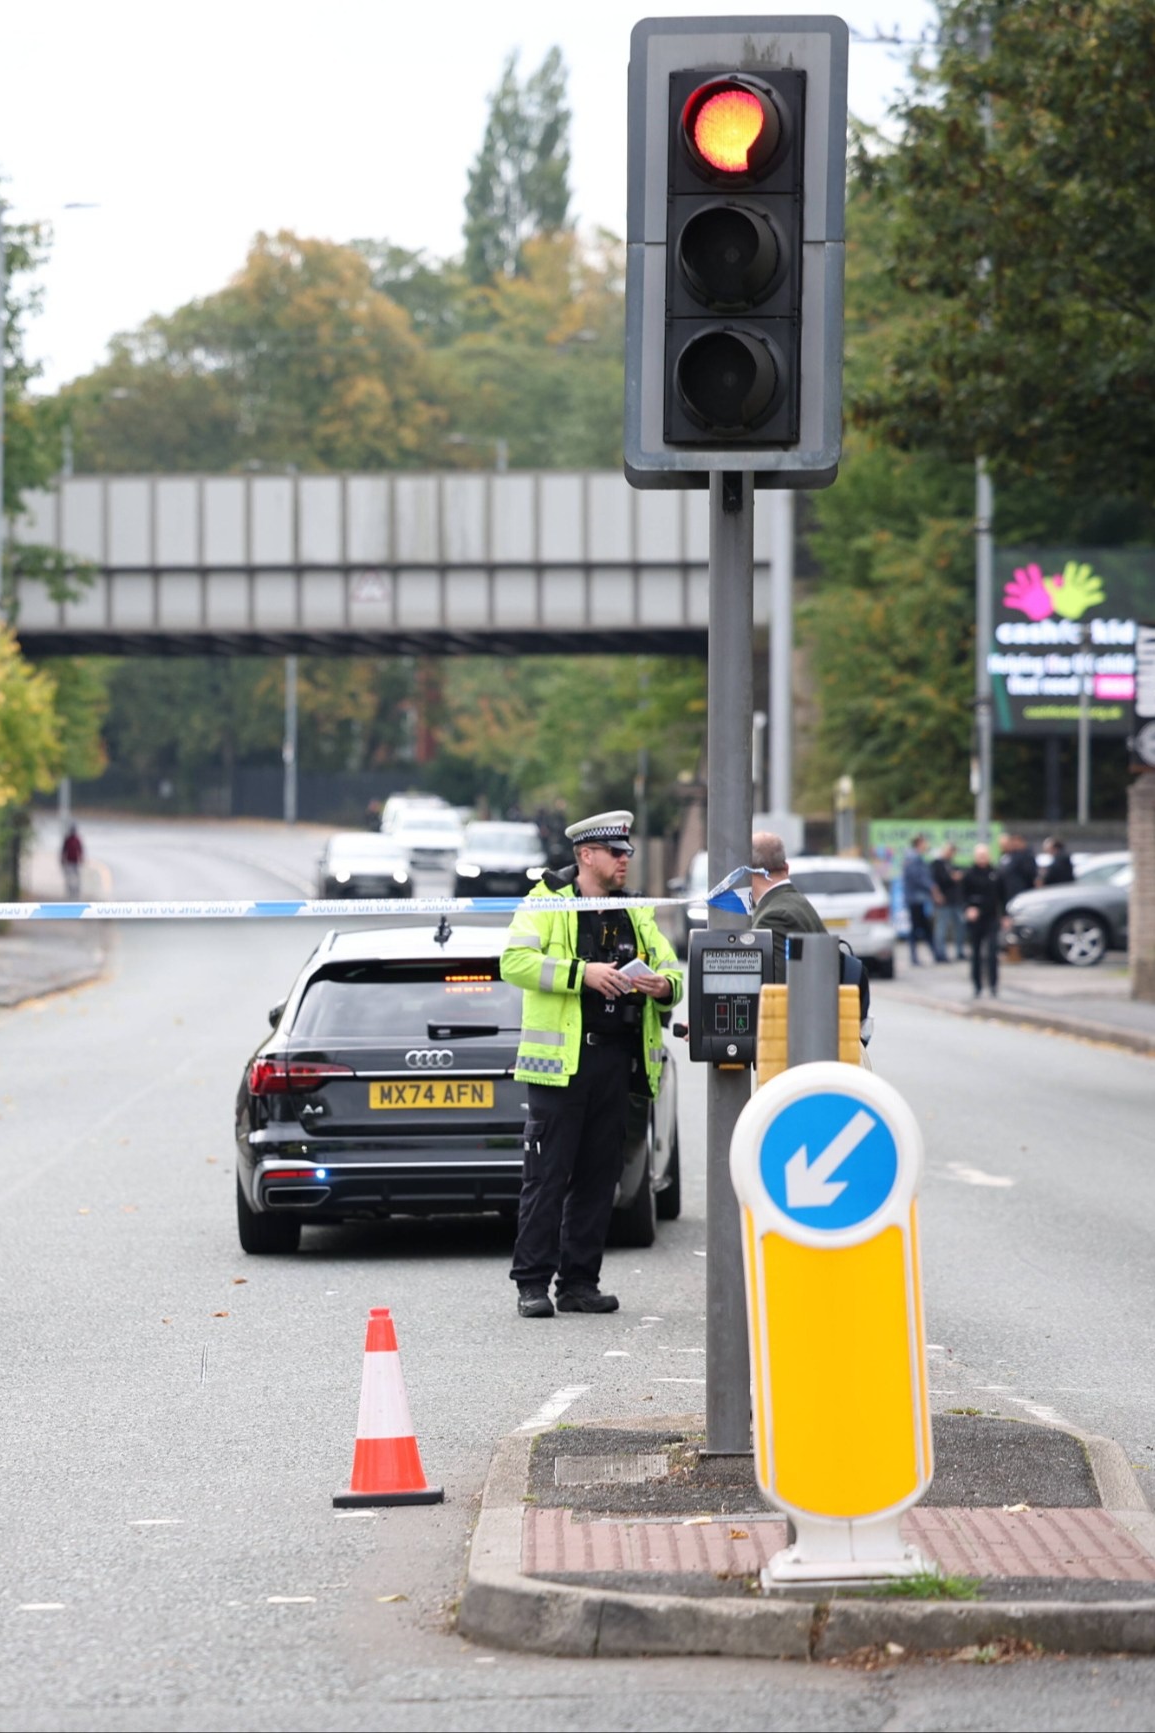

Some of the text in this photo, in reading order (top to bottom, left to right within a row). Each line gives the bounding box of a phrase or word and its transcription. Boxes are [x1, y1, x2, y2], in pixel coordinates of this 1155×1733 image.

[380, 1084, 484, 1104] MX74 AFN
[303, 1104, 323, 1114] A4
